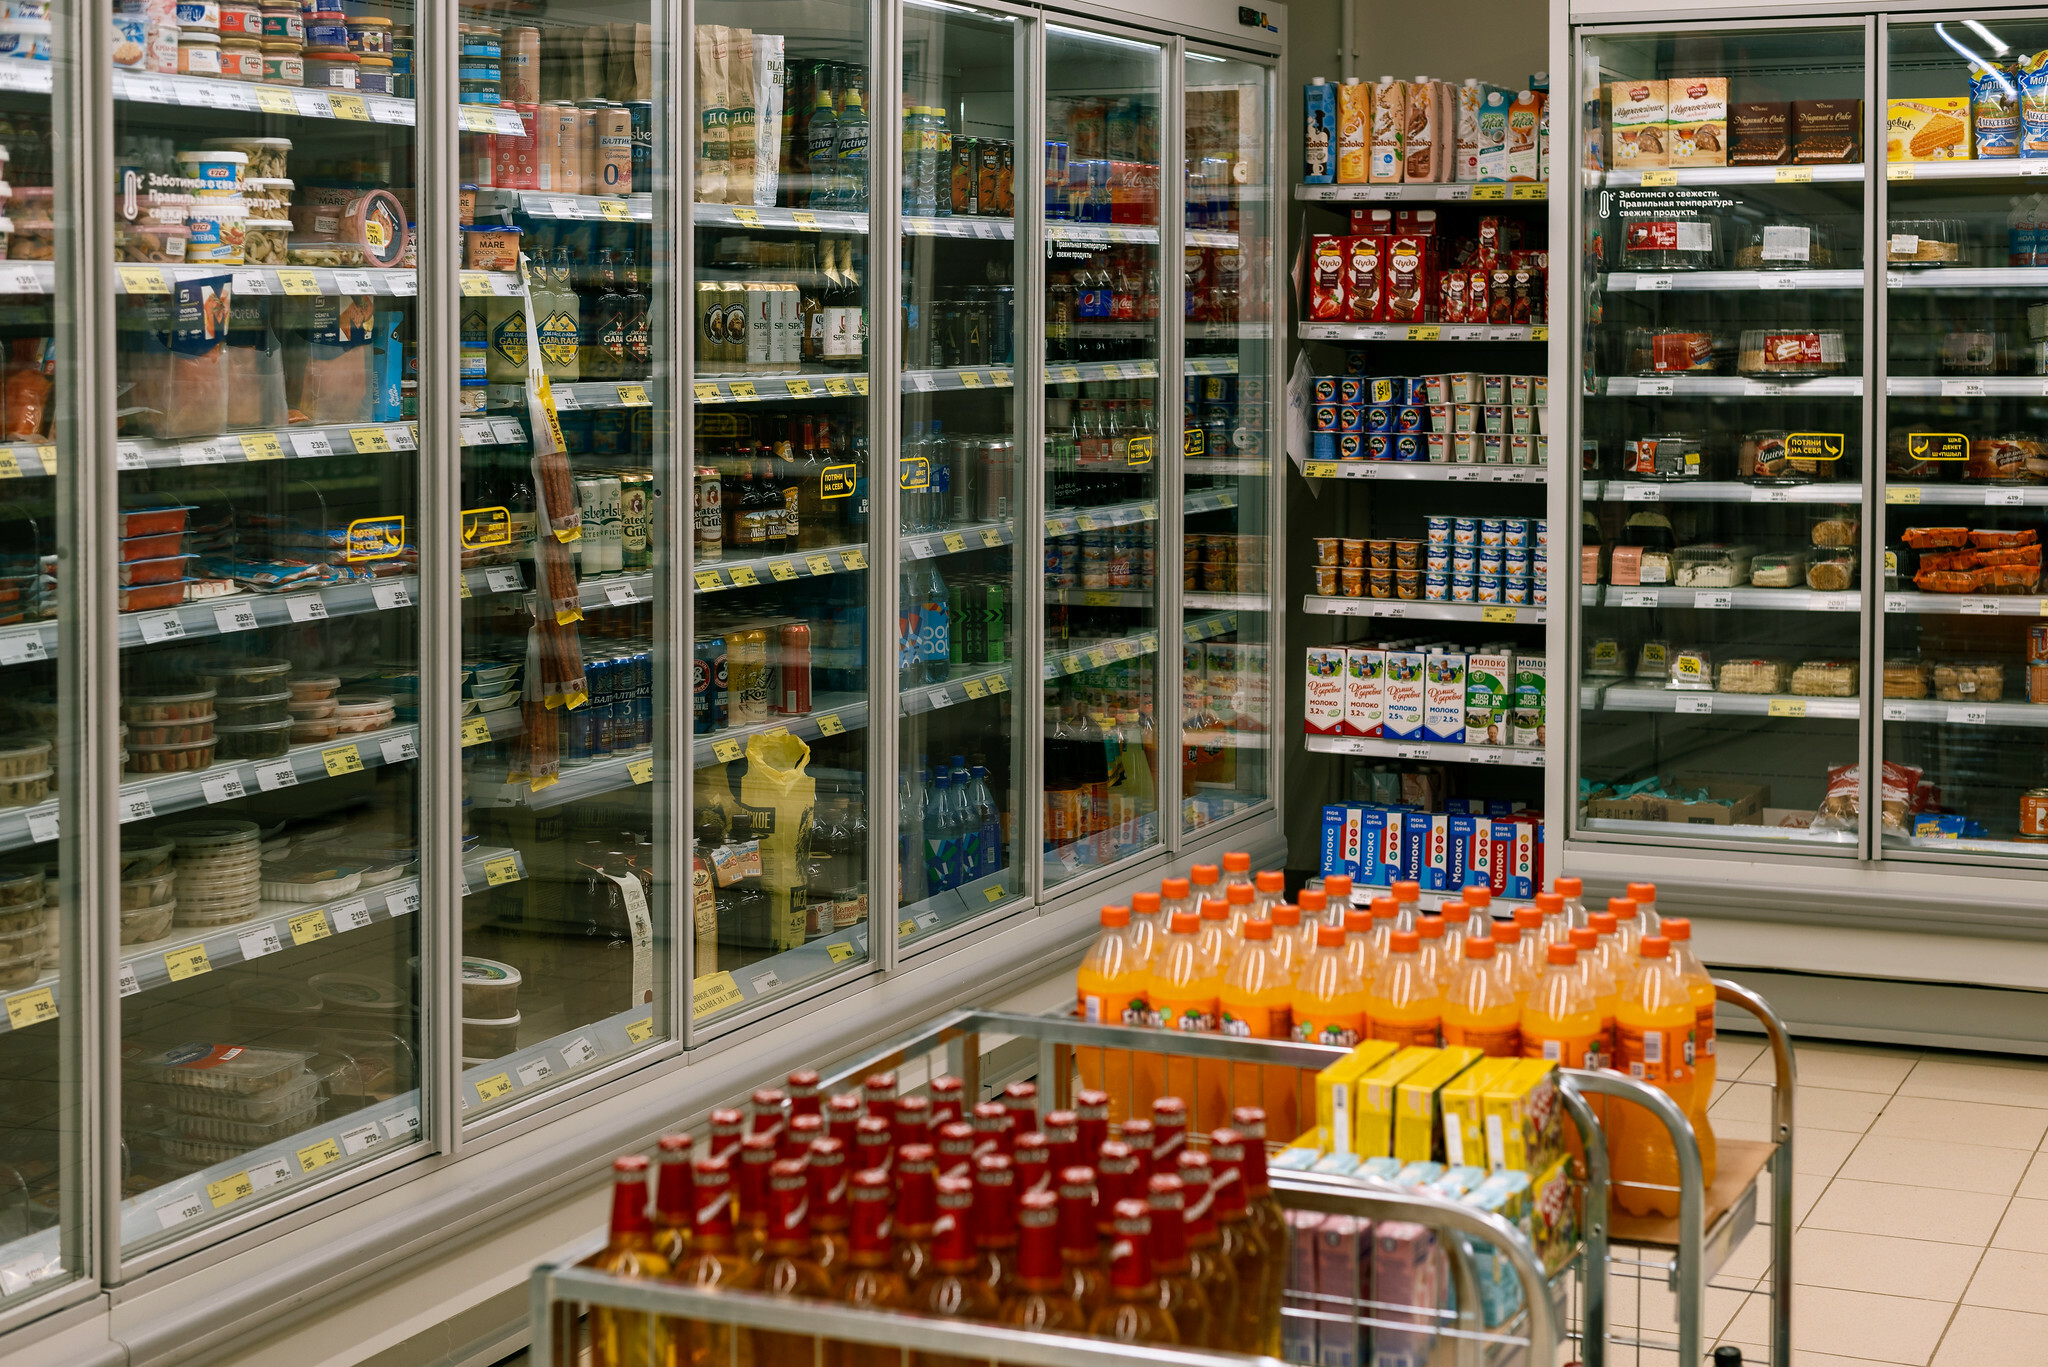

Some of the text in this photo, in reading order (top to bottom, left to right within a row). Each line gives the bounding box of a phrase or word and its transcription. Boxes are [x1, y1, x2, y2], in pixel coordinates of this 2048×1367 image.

[1614, 104, 1664, 118] Муравейник
[1671, 102, 1723, 117] Муравейник
[1769, 116, 1786, 124] Cake
[1835, 112, 1852, 121] Cake
[1482, 118, 1504, 130] Milk
[1512, 117, 1534, 128] Milk
[841, 138, 867, 149] Active
[1619, 190, 1666, 199] Заботимся
[1619, 199, 1674, 209] Правильная
[1676, 199, 1733, 208] температура
[1653, 209, 1697, 217] продукты
[1320, 259, 1341, 267] Чудо
[1356, 258, 1376, 267] Чудо
[1396, 258, 1417, 267] Чудо
[825, 473, 843, 482] ПОТЯНИ
[1471, 658, 1506, 668] МОЛОКО
[1679, 665, 1698, 674] -30%
[1324, 828, 1334, 871] Молоко
[1365, 832, 1375, 875] Молоко
[1409, 836, 1419, 880] Молоко
[1453, 838, 1463, 883] Молоко
[1494, 844, 1504, 888] Молоко
